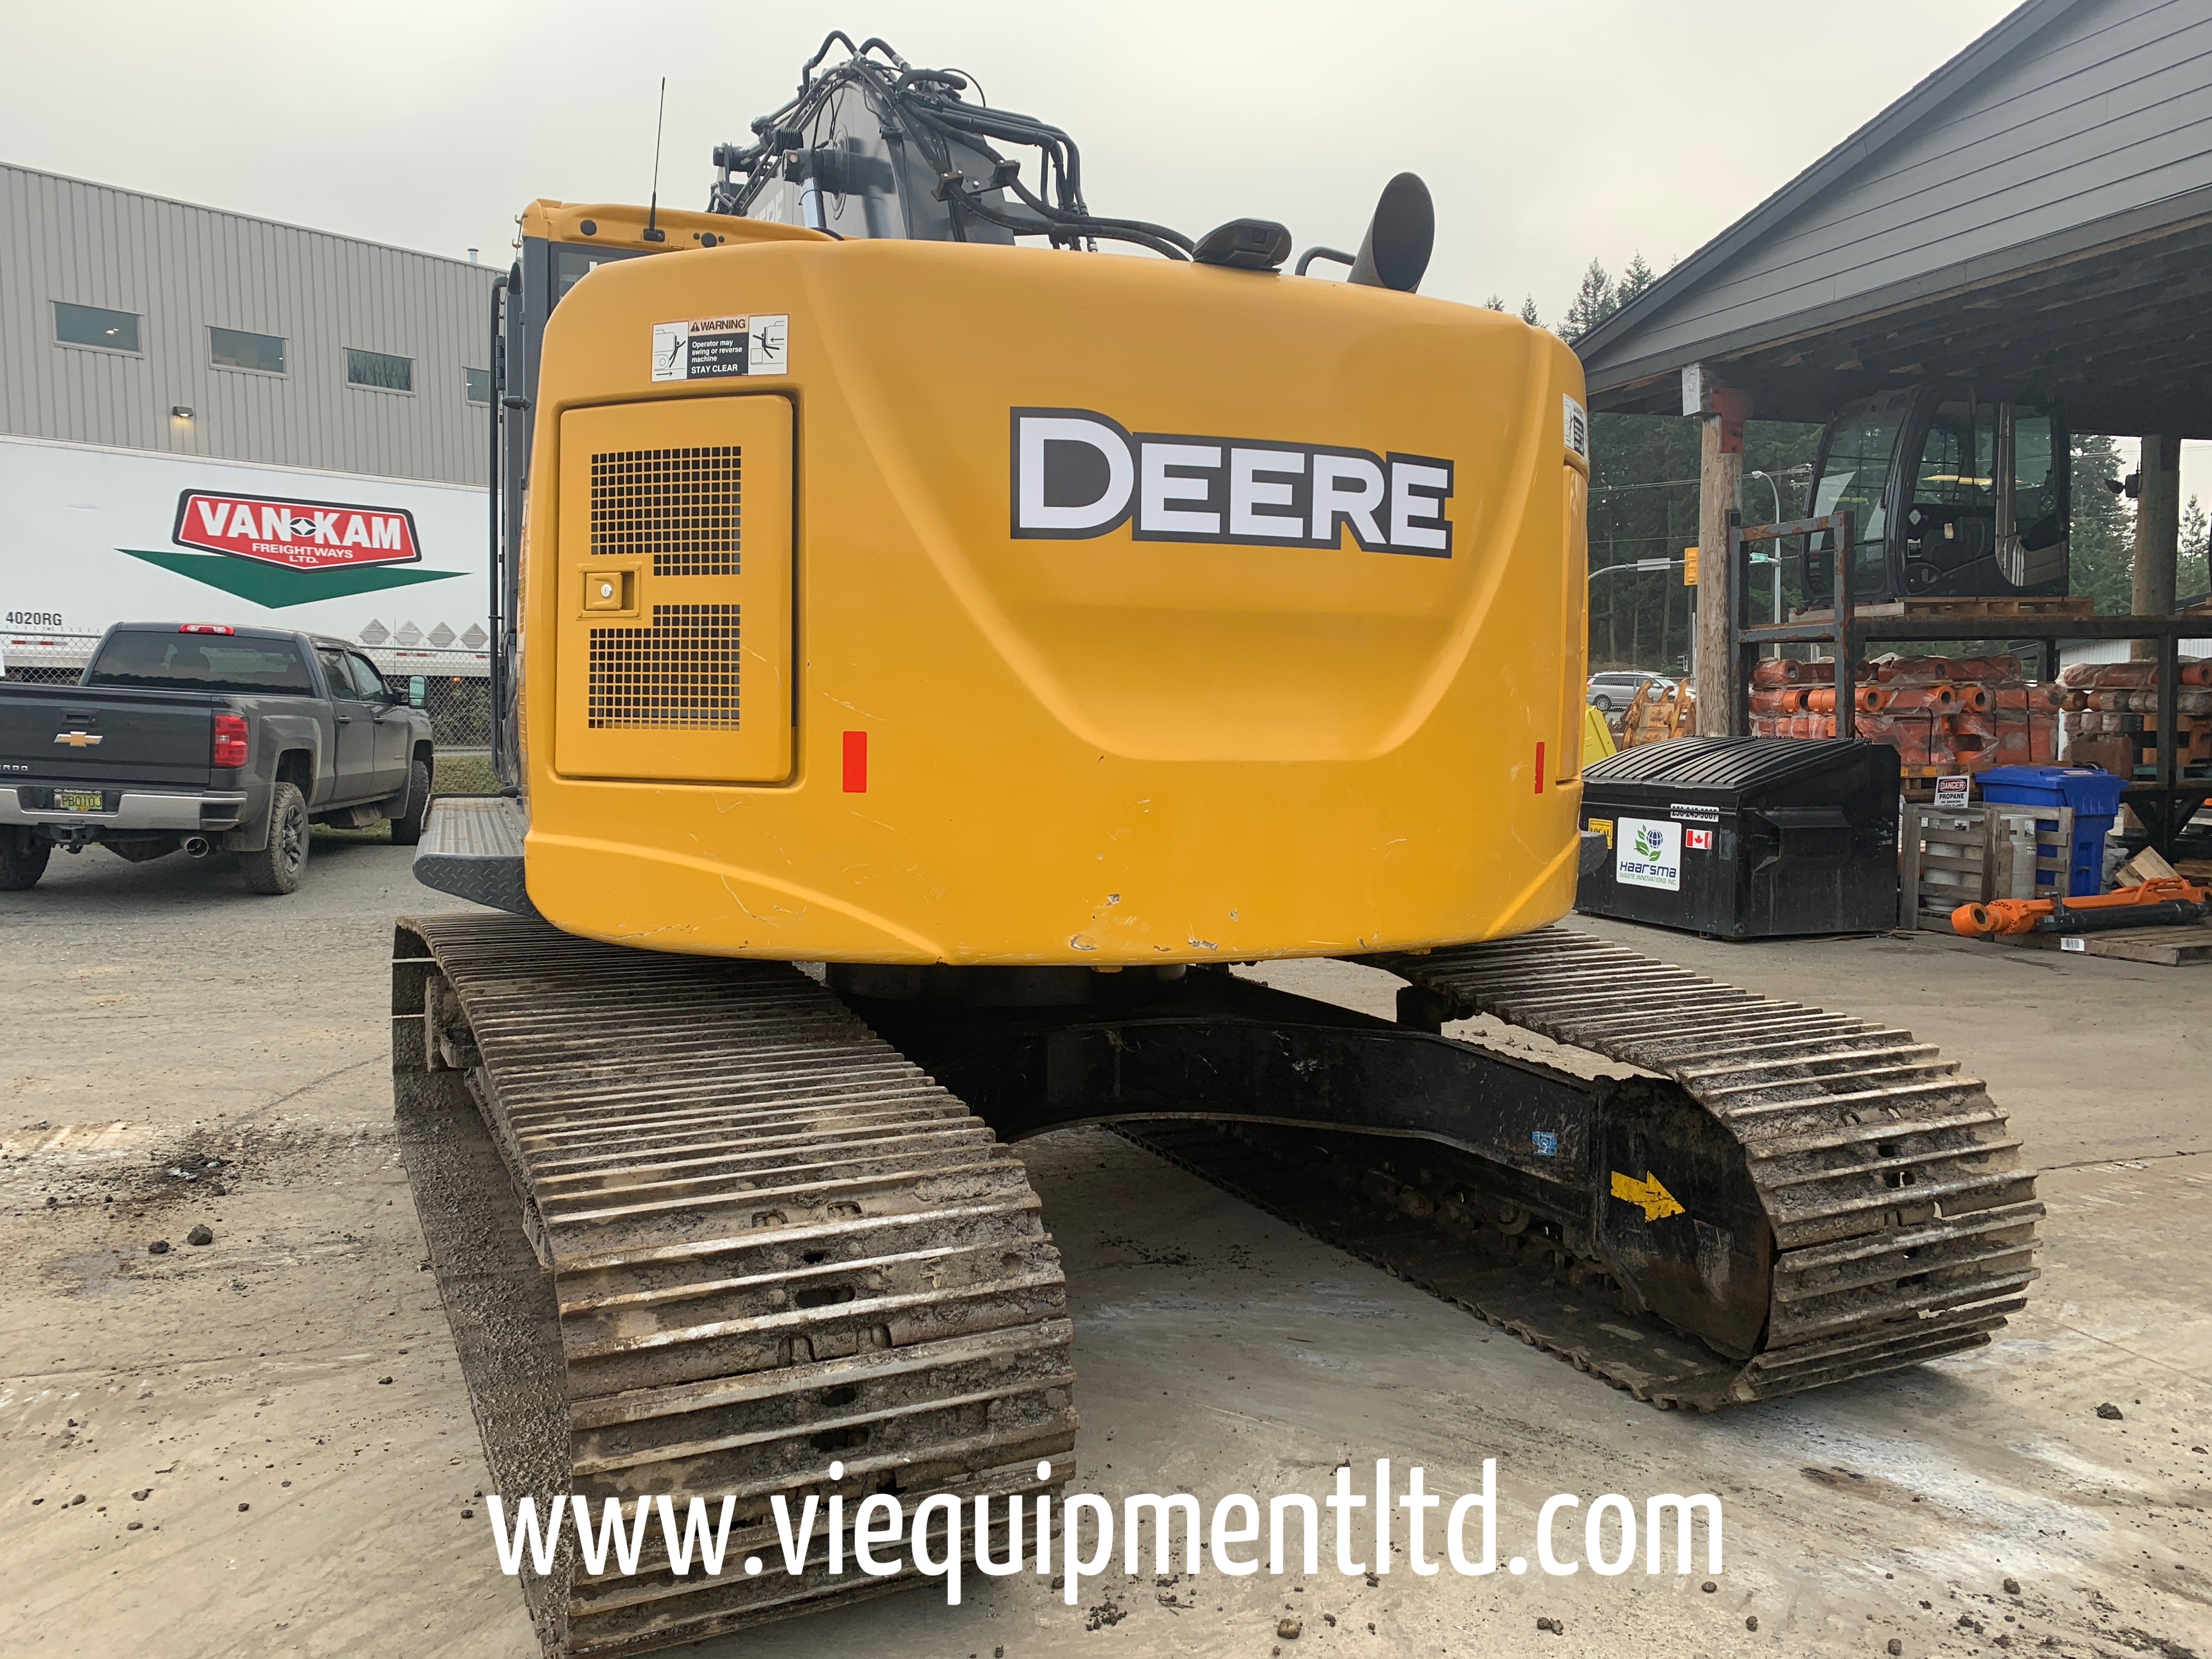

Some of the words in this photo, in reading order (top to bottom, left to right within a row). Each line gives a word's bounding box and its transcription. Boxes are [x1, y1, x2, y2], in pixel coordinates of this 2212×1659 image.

[701, 319, 746, 331] WARNING
[692, 341, 719, 349] Operator
[691, 365, 710, 374] STAY
[712, 364, 738, 373] CLEAR
[1011, 407, 1454, 558] DEERE
[252, 543, 353, 558] FREIGHTWAYS
[289, 555, 319, 564] LTD.
[5, 611, 62, 626] 4020RG
[1940, 781, 1964, 790] DANGER
[1636, 874, 1667, 884] INNOVATIONS
